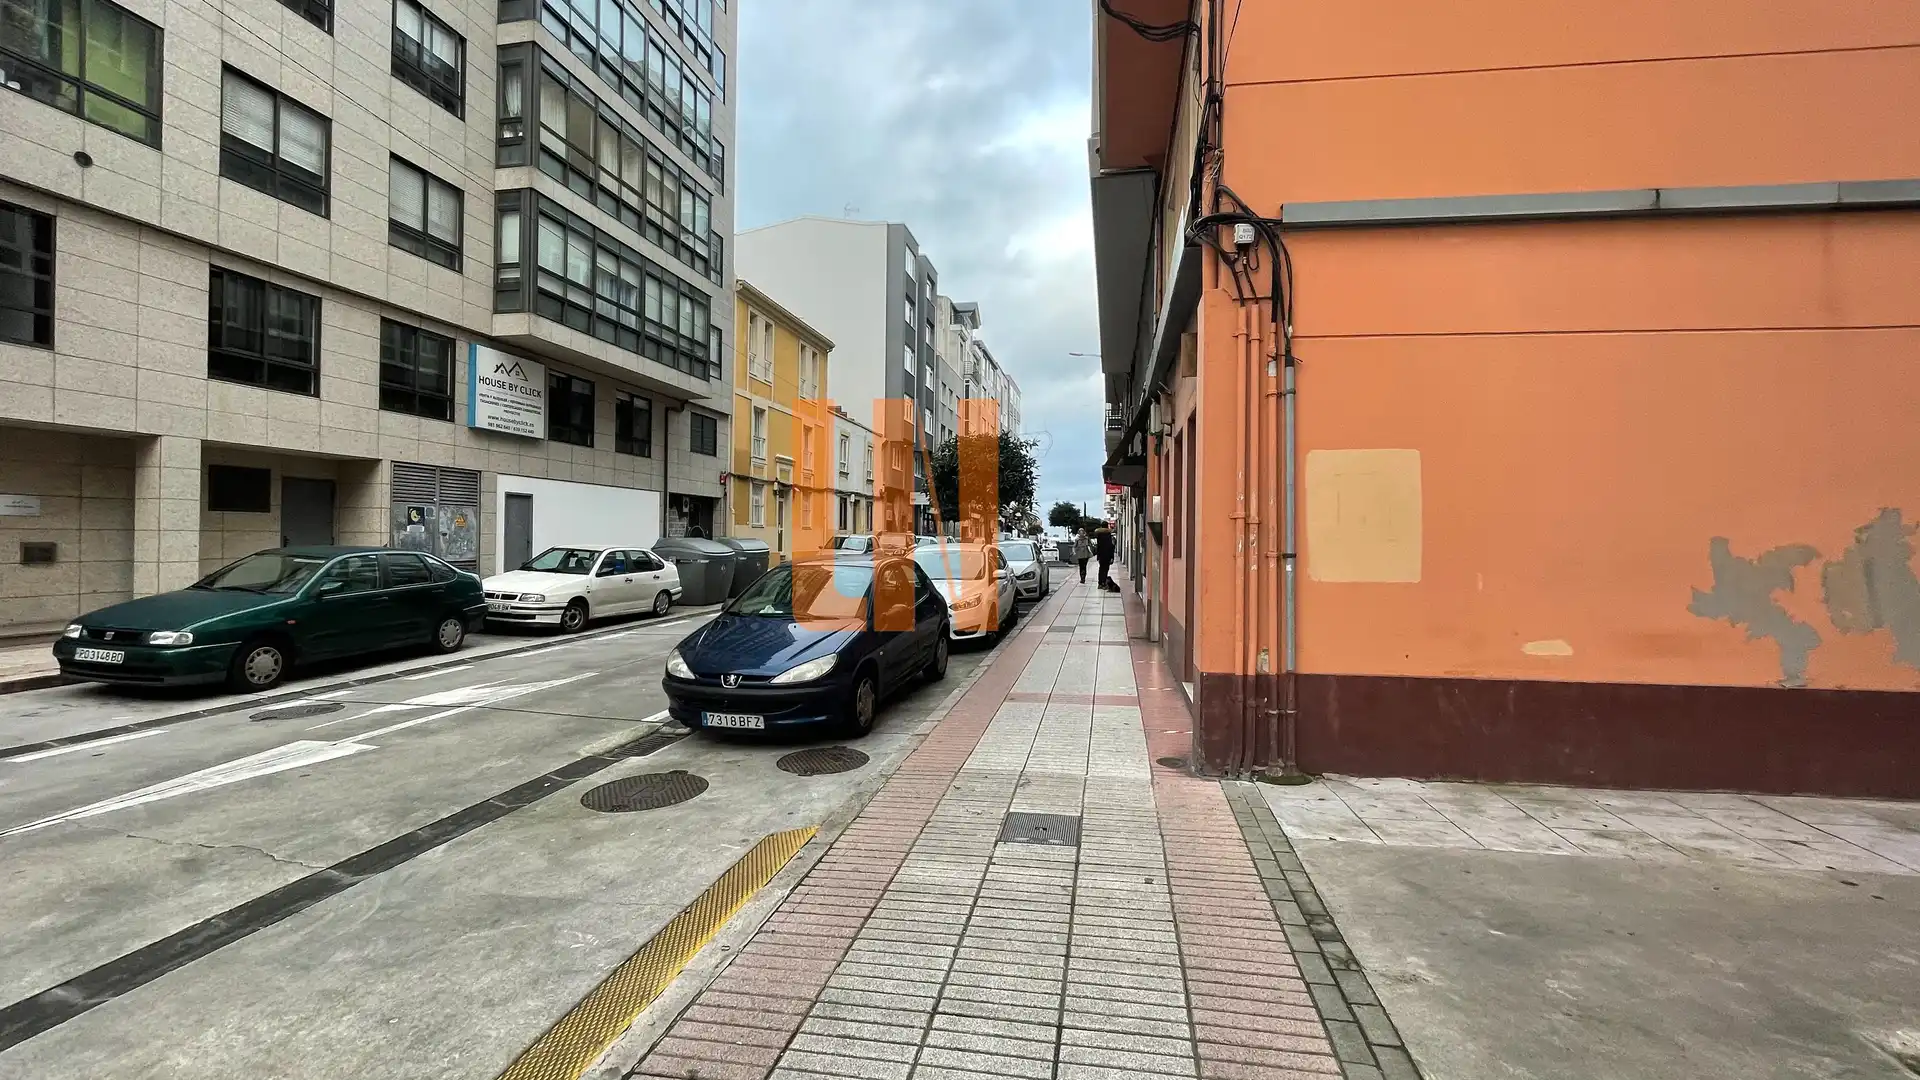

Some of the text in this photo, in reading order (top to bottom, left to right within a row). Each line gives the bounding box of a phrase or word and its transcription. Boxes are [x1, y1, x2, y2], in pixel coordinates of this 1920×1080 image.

[479, 376, 542, 398] HOUSE BY CLICK
[488, 415, 534, 427] www.housebyclick.es
